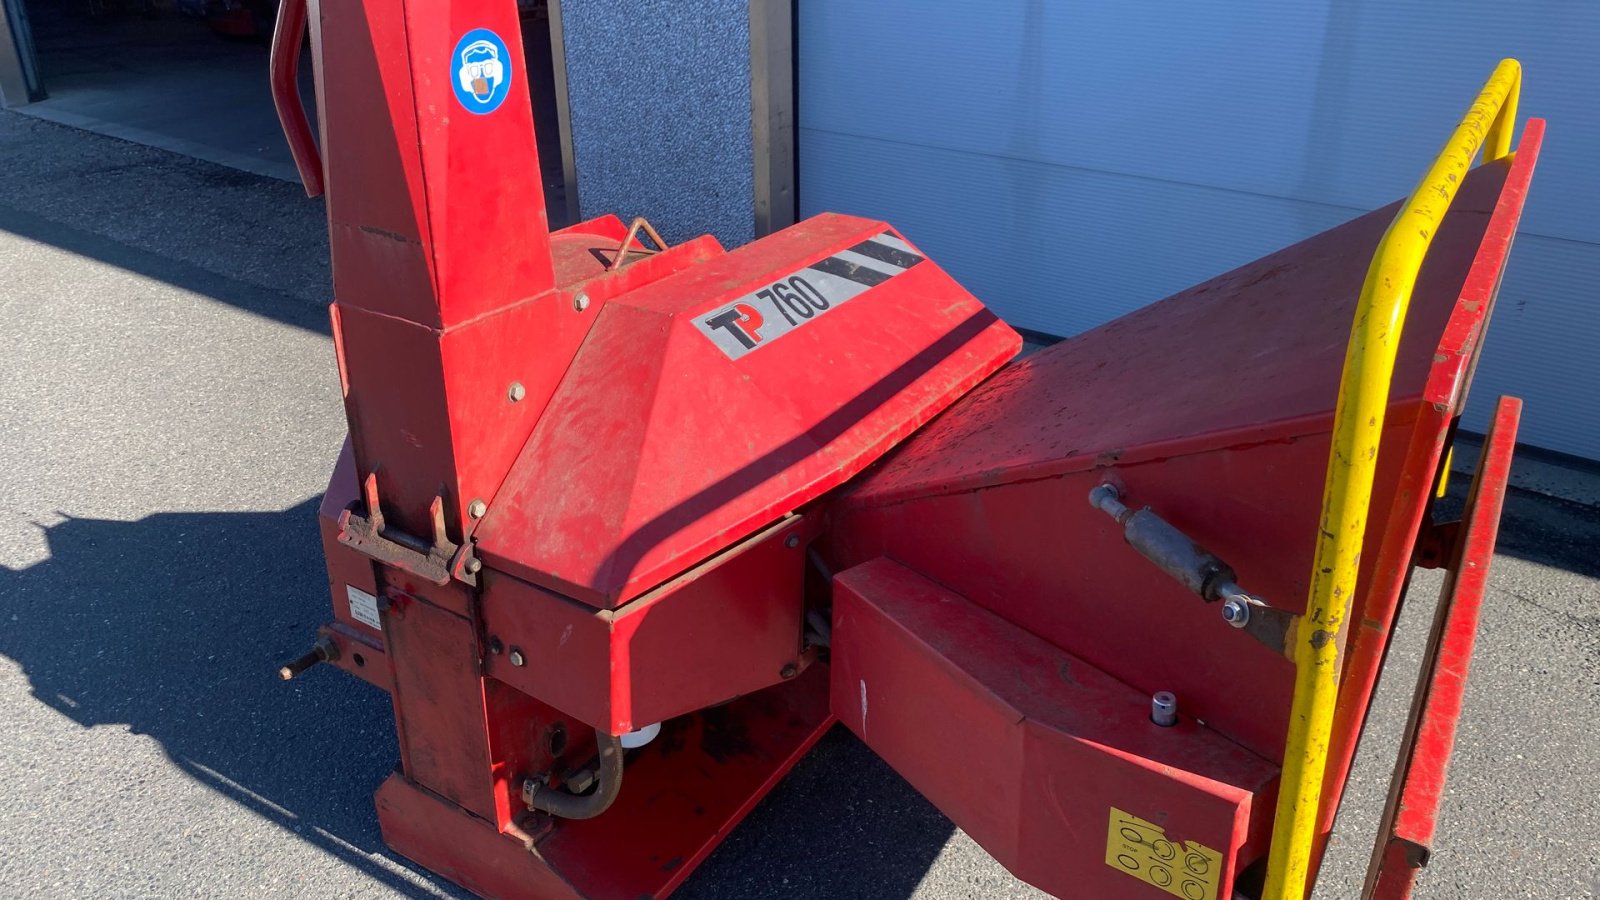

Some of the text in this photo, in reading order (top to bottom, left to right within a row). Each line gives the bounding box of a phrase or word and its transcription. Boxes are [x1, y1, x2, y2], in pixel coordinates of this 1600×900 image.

[705, 277, 830, 349] TP 760
[1122, 844, 1138, 853] STOP
